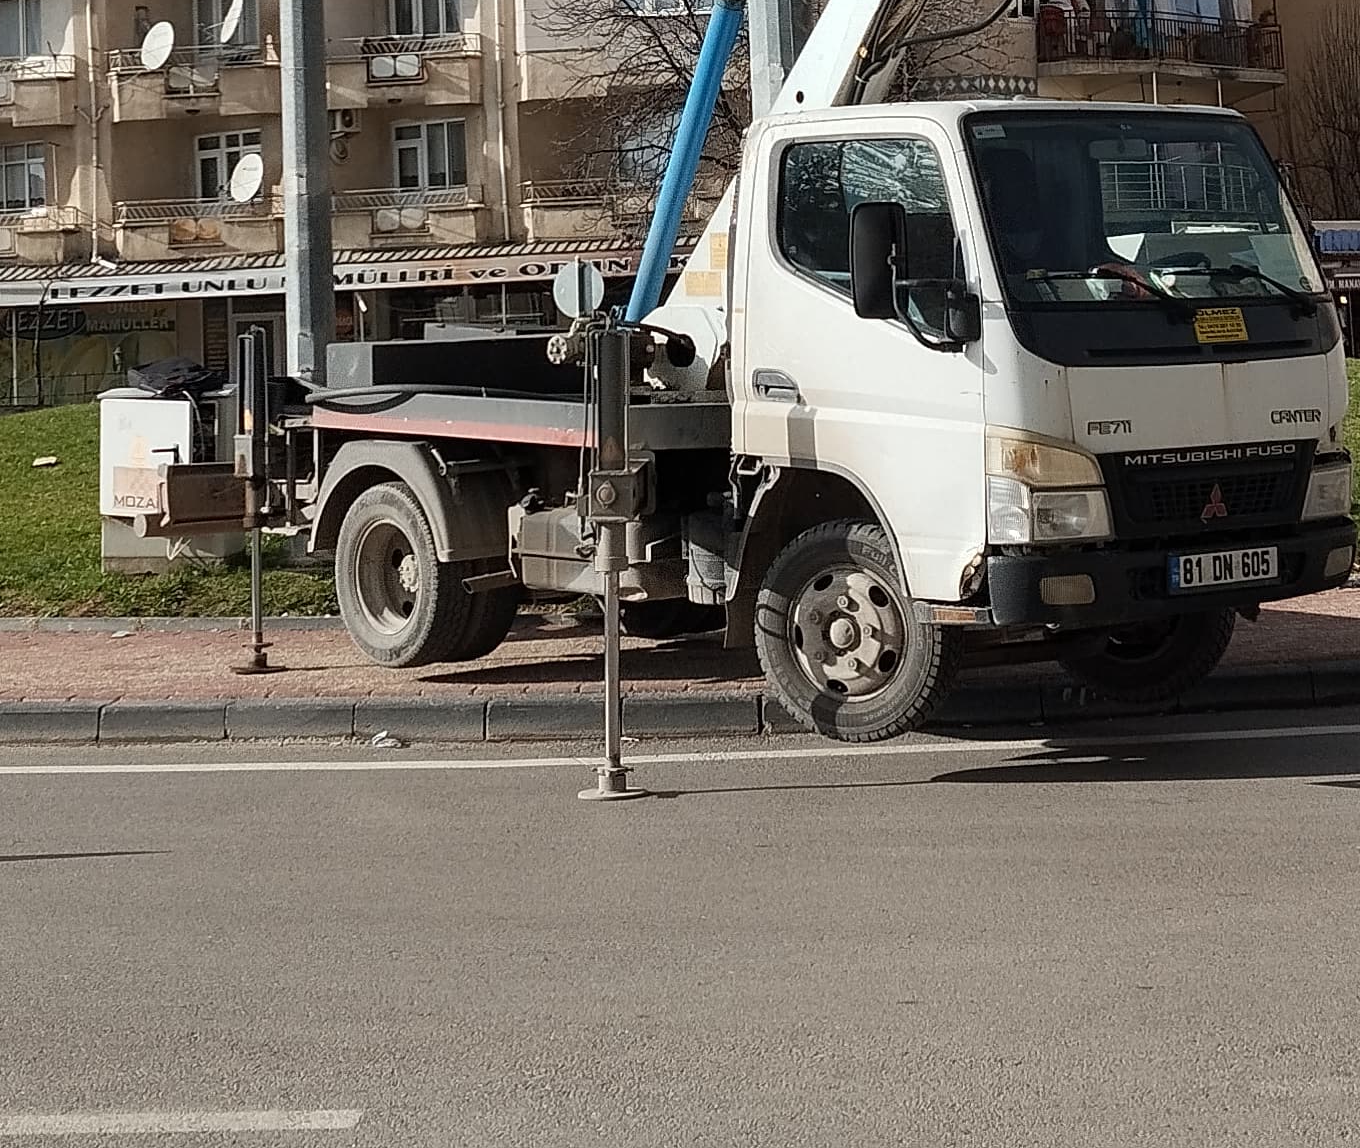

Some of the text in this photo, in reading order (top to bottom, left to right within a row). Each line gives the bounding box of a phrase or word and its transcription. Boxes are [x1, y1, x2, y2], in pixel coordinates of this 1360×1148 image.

[51, 281, 169, 300] LEZZET
[182, 277, 267, 294] UNLU
[469, 267, 507, 279] ve
[5, 308, 81, 332] LEZZET
[1271, 409, 1322, 424] CANTER
[1124, 443, 1296, 466] MITSUBISHI FUSO
[1182, 550, 1270, 585] 81 DN 605
